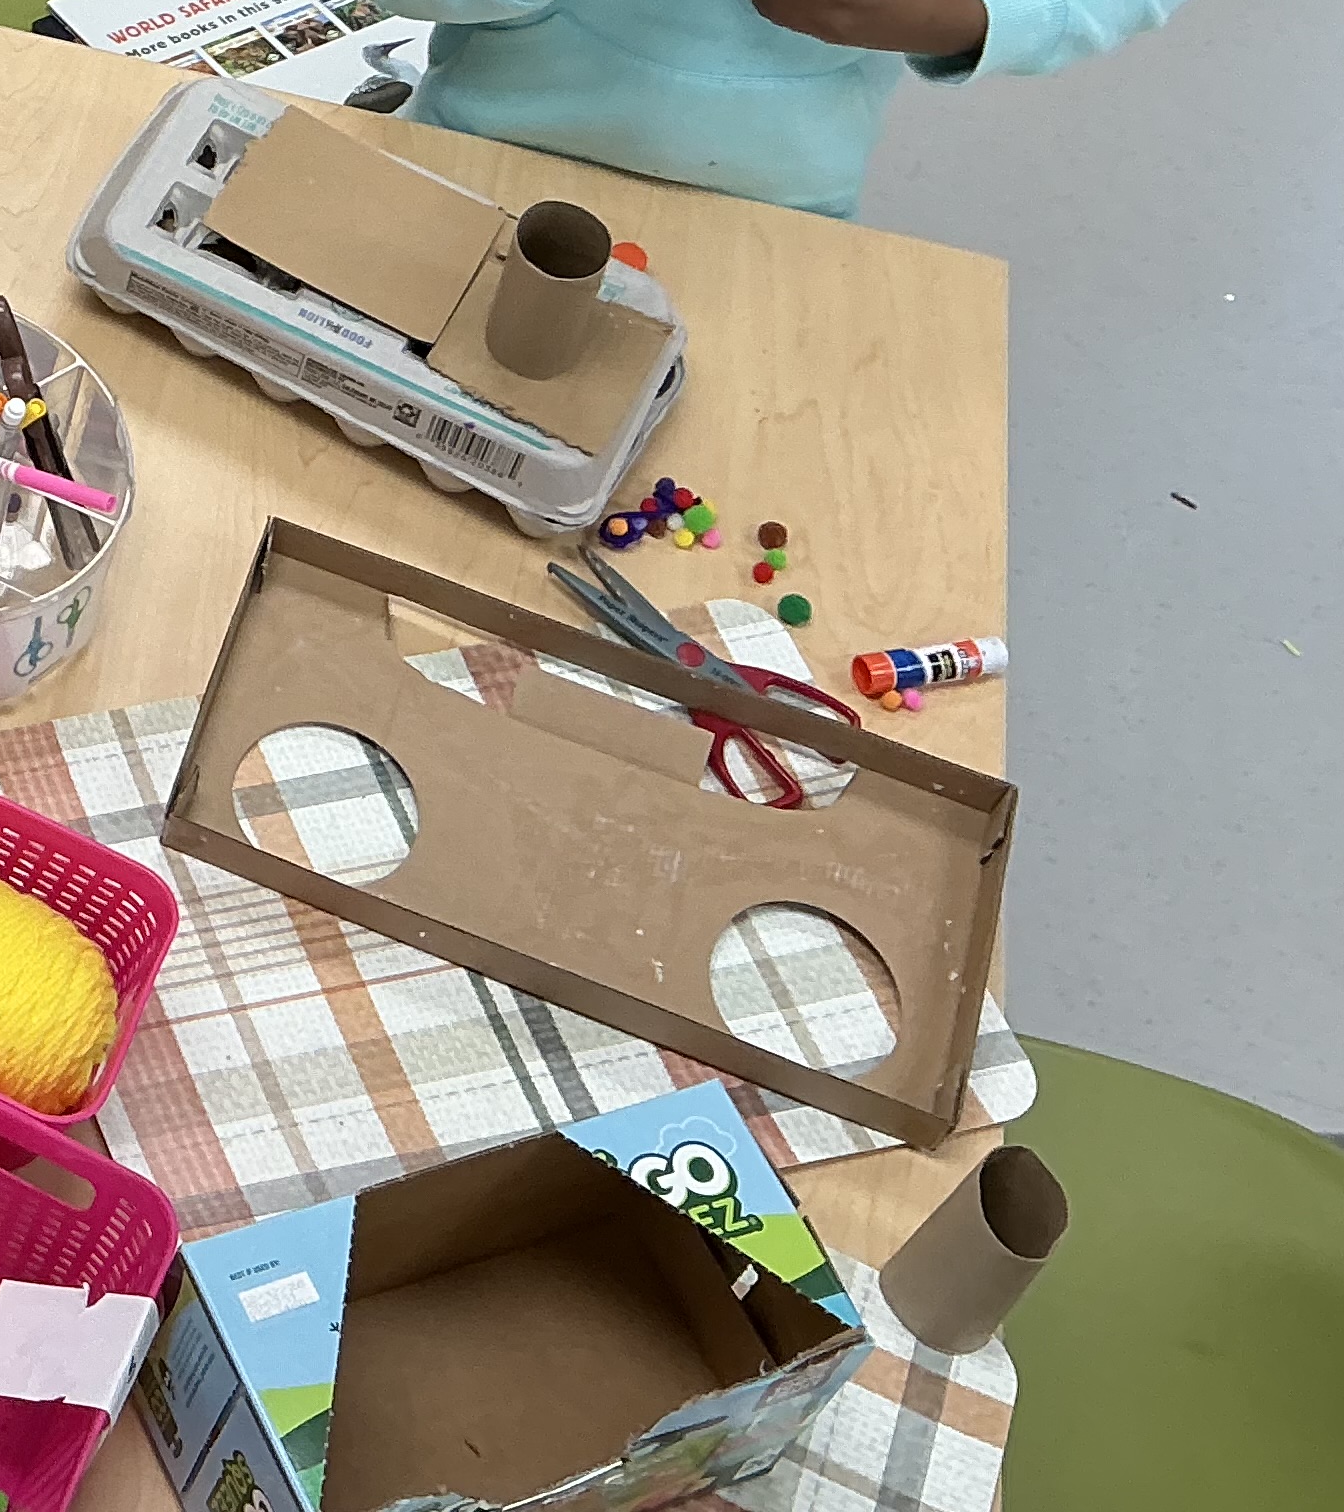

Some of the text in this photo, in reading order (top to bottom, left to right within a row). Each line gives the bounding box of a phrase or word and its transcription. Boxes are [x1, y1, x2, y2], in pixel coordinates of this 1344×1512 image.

[107, 13, 175, 44] WORLD
[125, 40, 168, 58] More
[167, 22, 218, 44] books
[218, 13, 237, 25] in
[238, 0, 270, 18] this
[297, 306, 372, 350] FOOD LION
